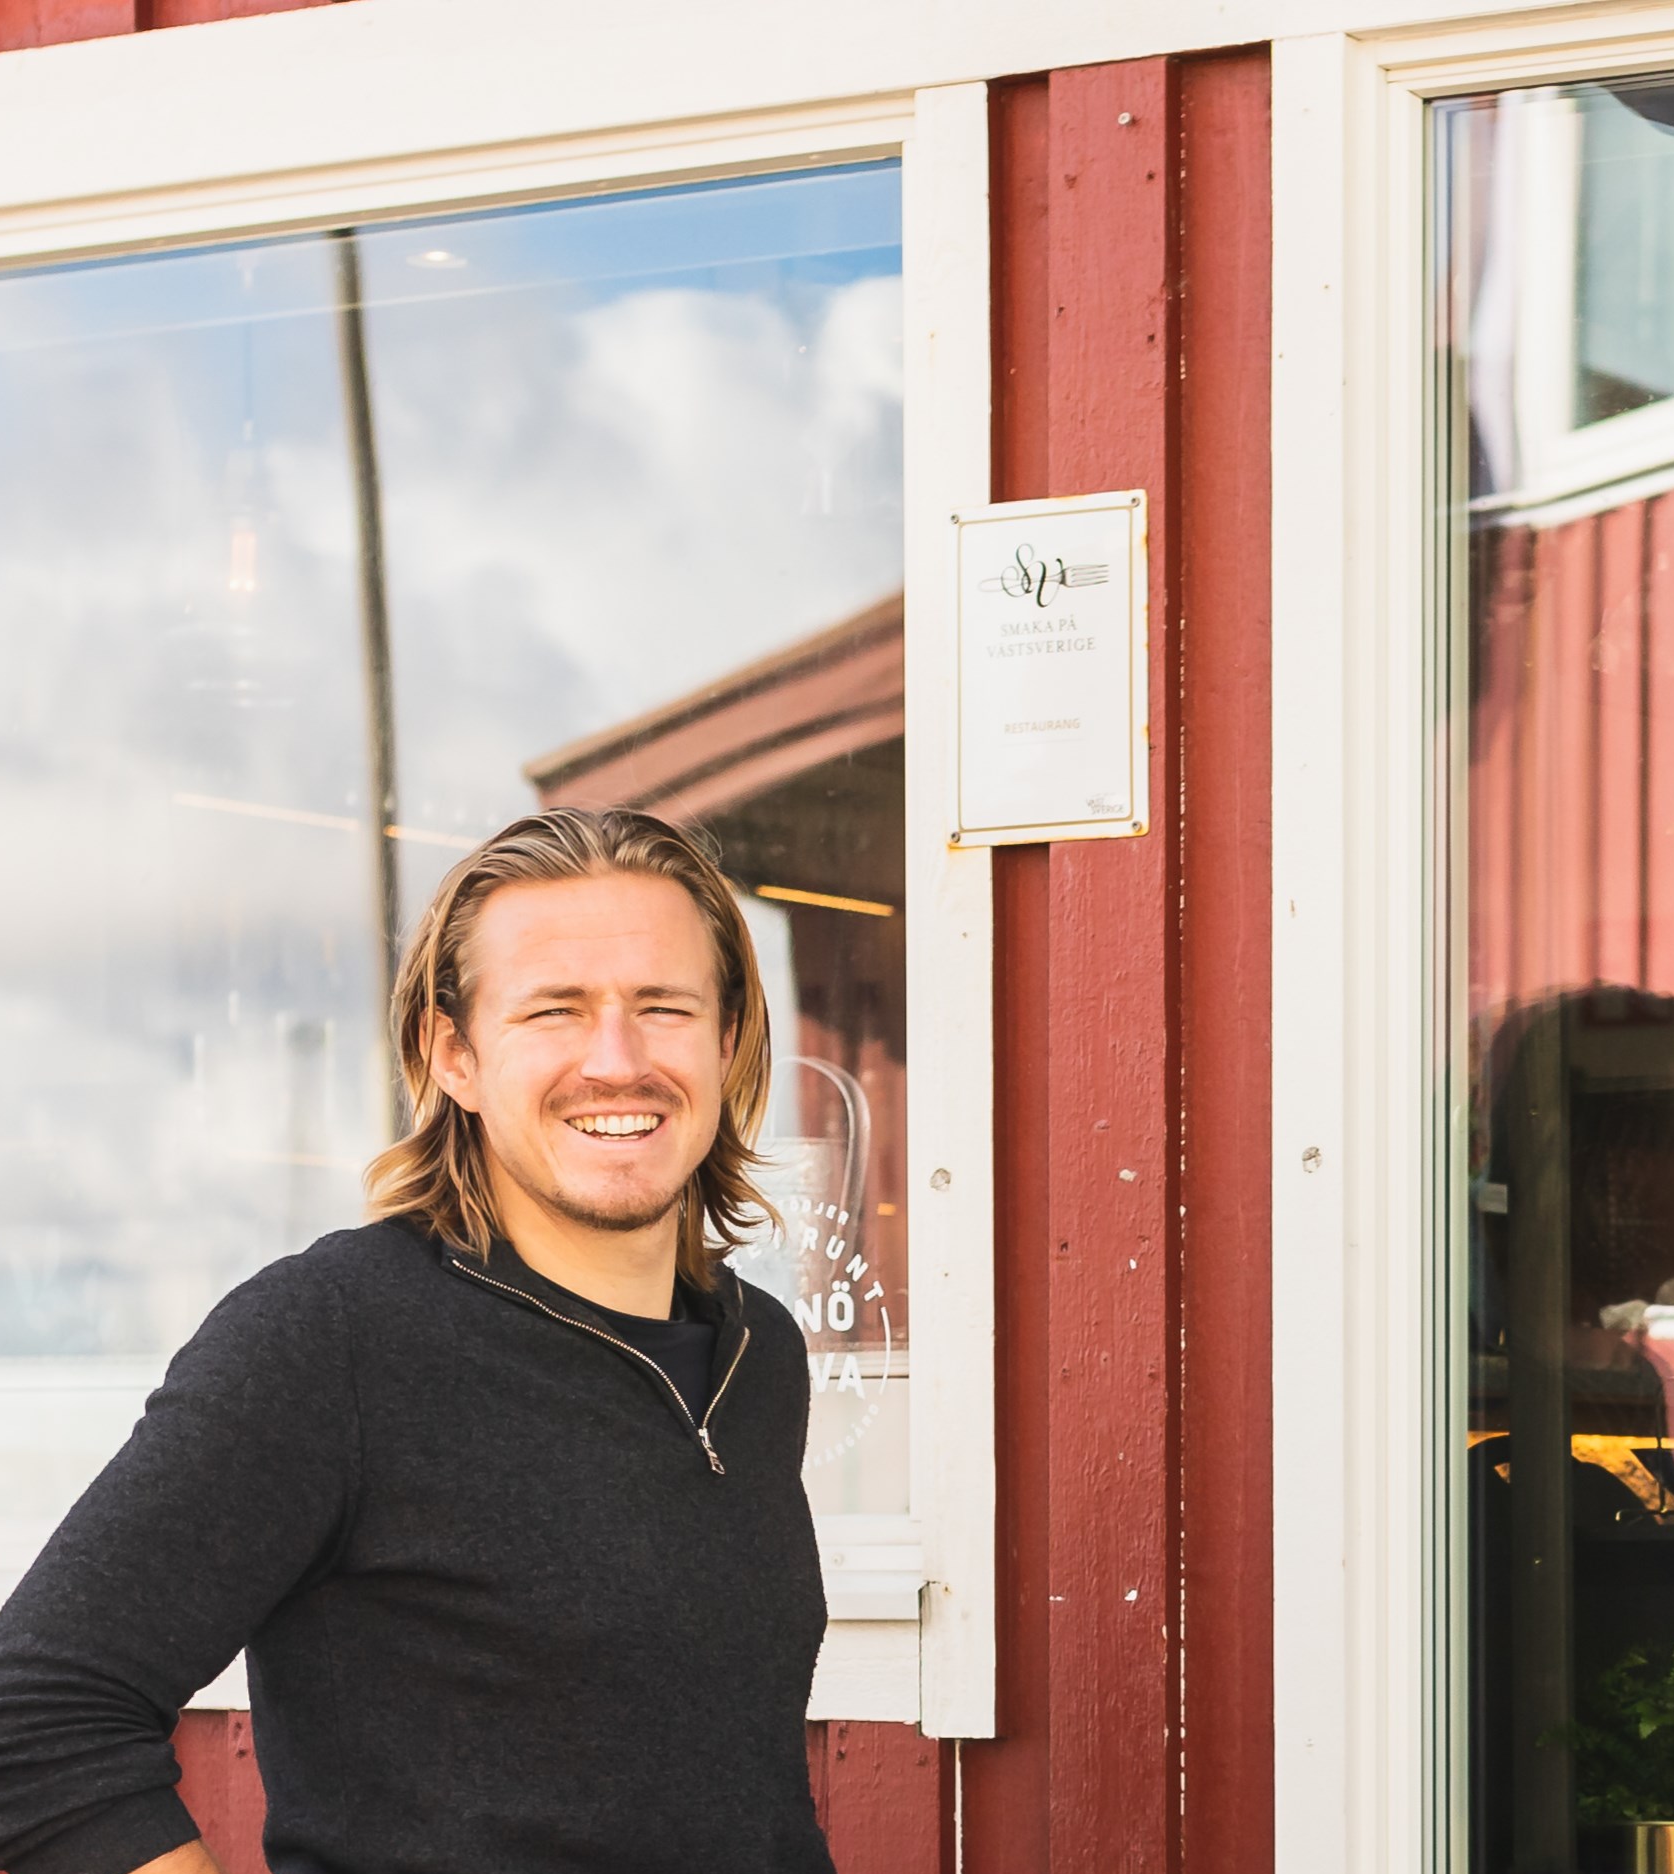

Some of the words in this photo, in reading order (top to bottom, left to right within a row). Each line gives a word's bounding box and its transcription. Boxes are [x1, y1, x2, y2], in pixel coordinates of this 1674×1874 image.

[1000, 620, 1054, 637] SMAKA
[1058, 614, 1078, 632] PÅ
[1003, 717, 1081, 735] RESTAURANG
[800, 1226, 884, 1302] RUNT
